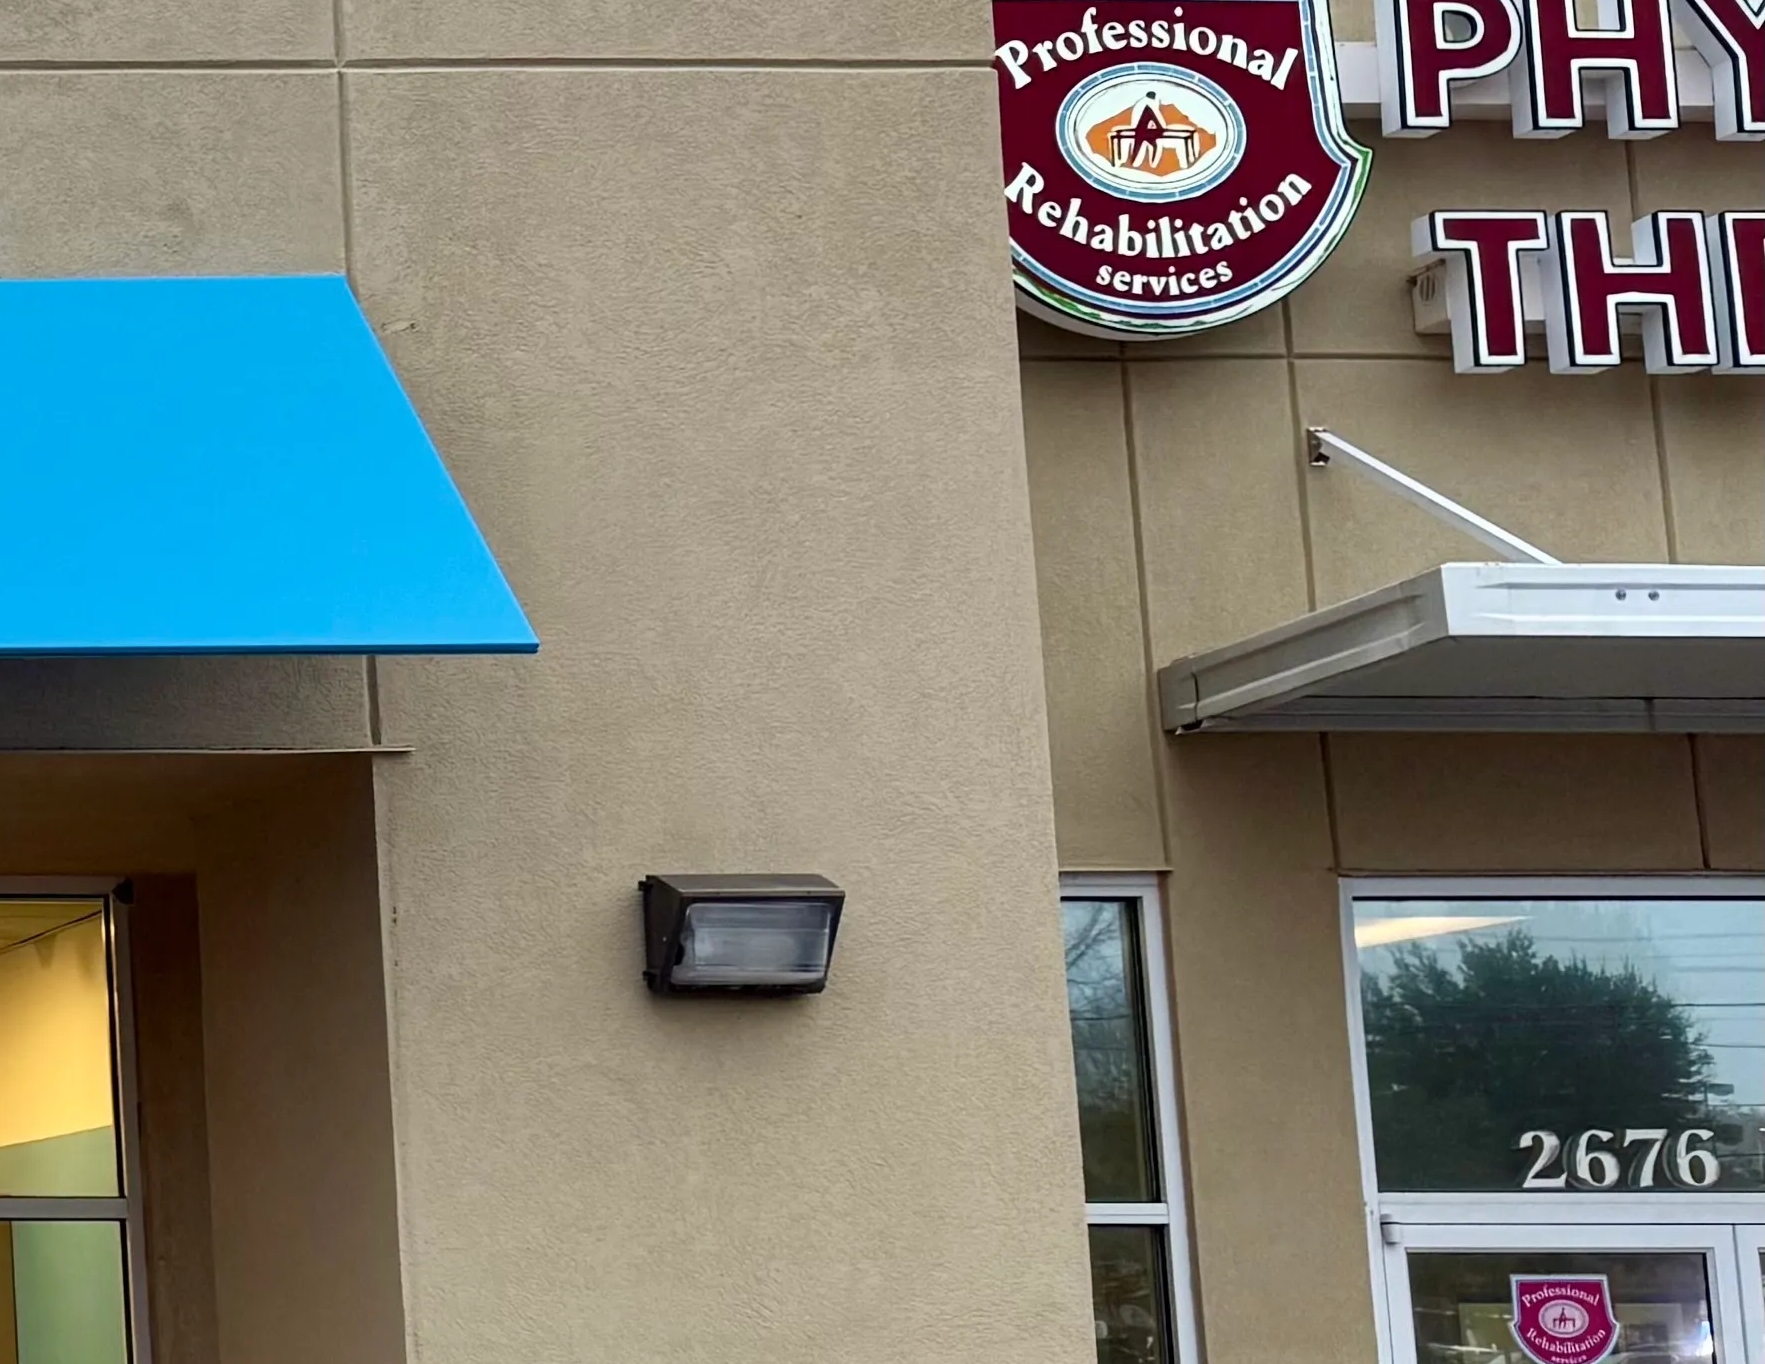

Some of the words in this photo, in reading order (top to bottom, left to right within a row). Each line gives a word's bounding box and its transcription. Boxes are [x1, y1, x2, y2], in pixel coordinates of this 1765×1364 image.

[994, 6, 1299, 90] Professional
[1004, 162, 1313, 259] Rehabilitation
[1095, 259, 1234, 296] services
[1519, 1128, 1720, 1189] 2676
[1521, 1284, 1601, 1308] Professional
[1526, 1327, 1606, 1354] Rehabilitation
